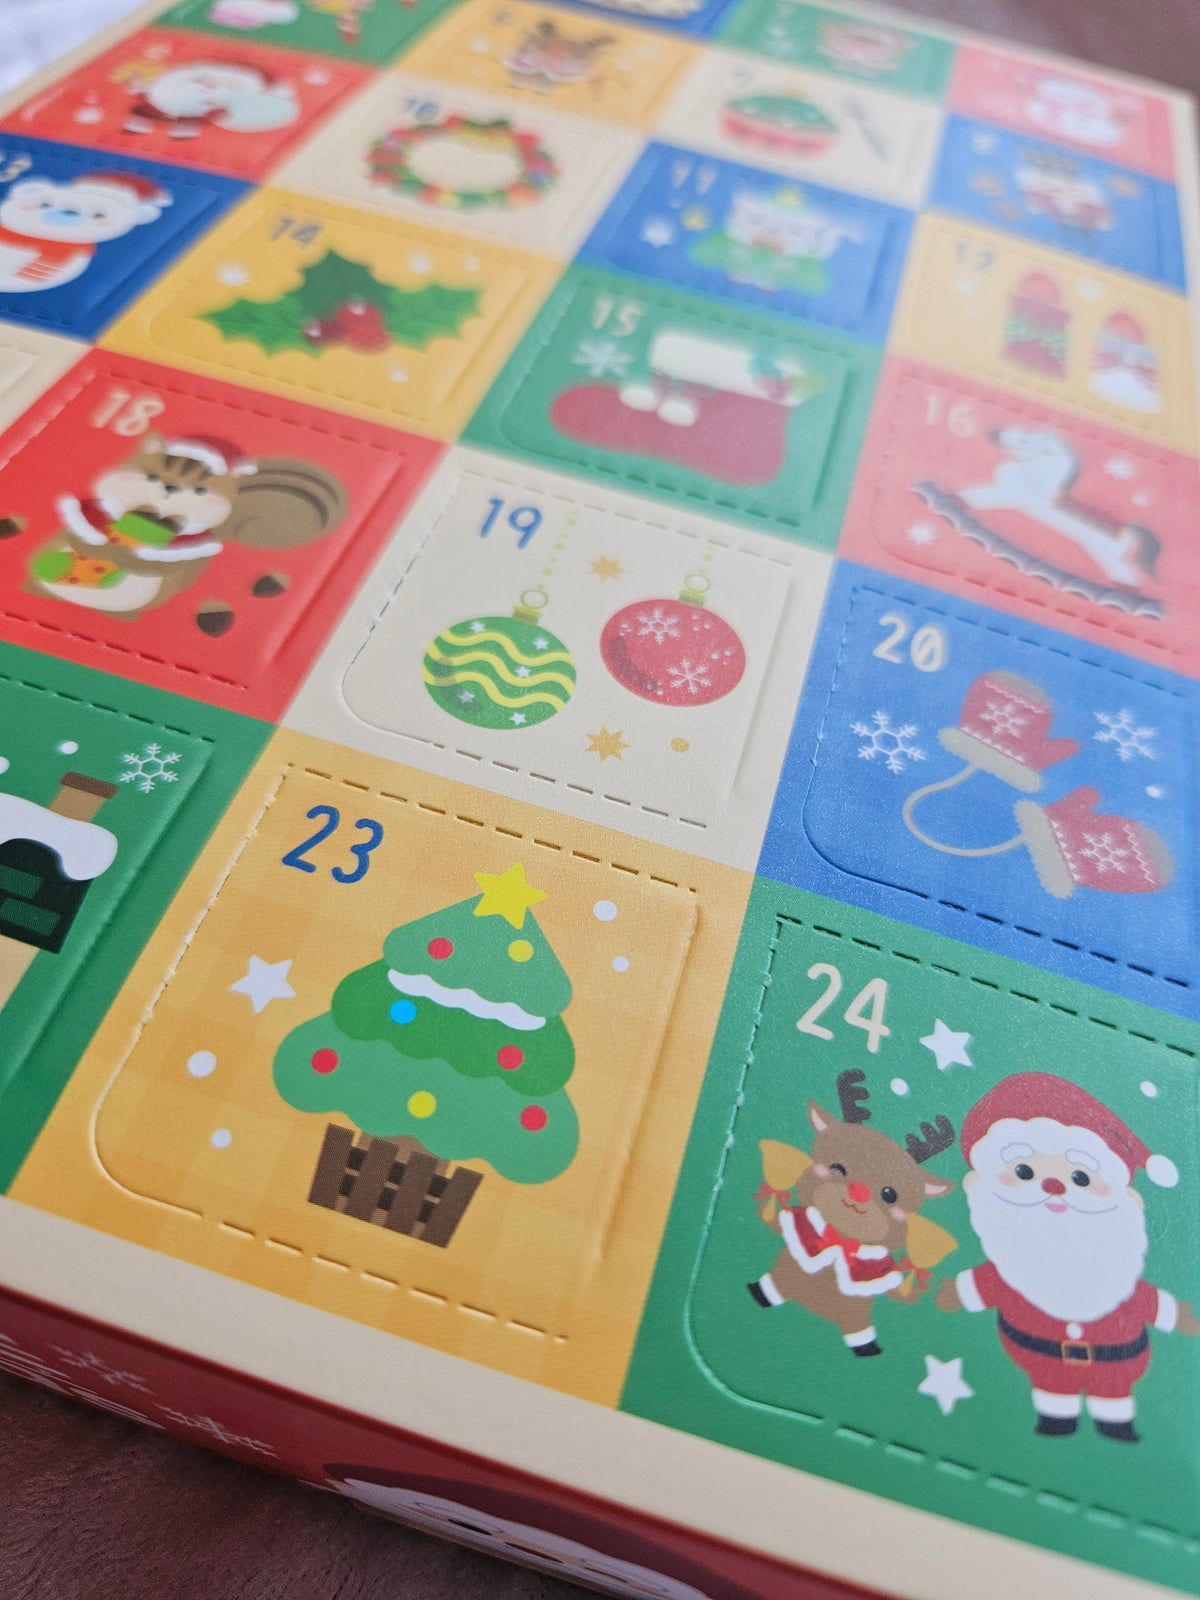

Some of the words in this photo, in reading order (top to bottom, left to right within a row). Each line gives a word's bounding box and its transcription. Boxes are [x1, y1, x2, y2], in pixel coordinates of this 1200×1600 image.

[0, 152, 32, 182] 3
[270, 215, 324, 248] 14
[592, 293, 646, 336] 15
[93, 389, 165, 435] 18
[926, 393, 976, 437] 16
[479, 496, 543, 550] 19
[872, 615, 950, 673] 20
[281, 804, 385, 884] 23
[795, 962, 891, 1053] 24
